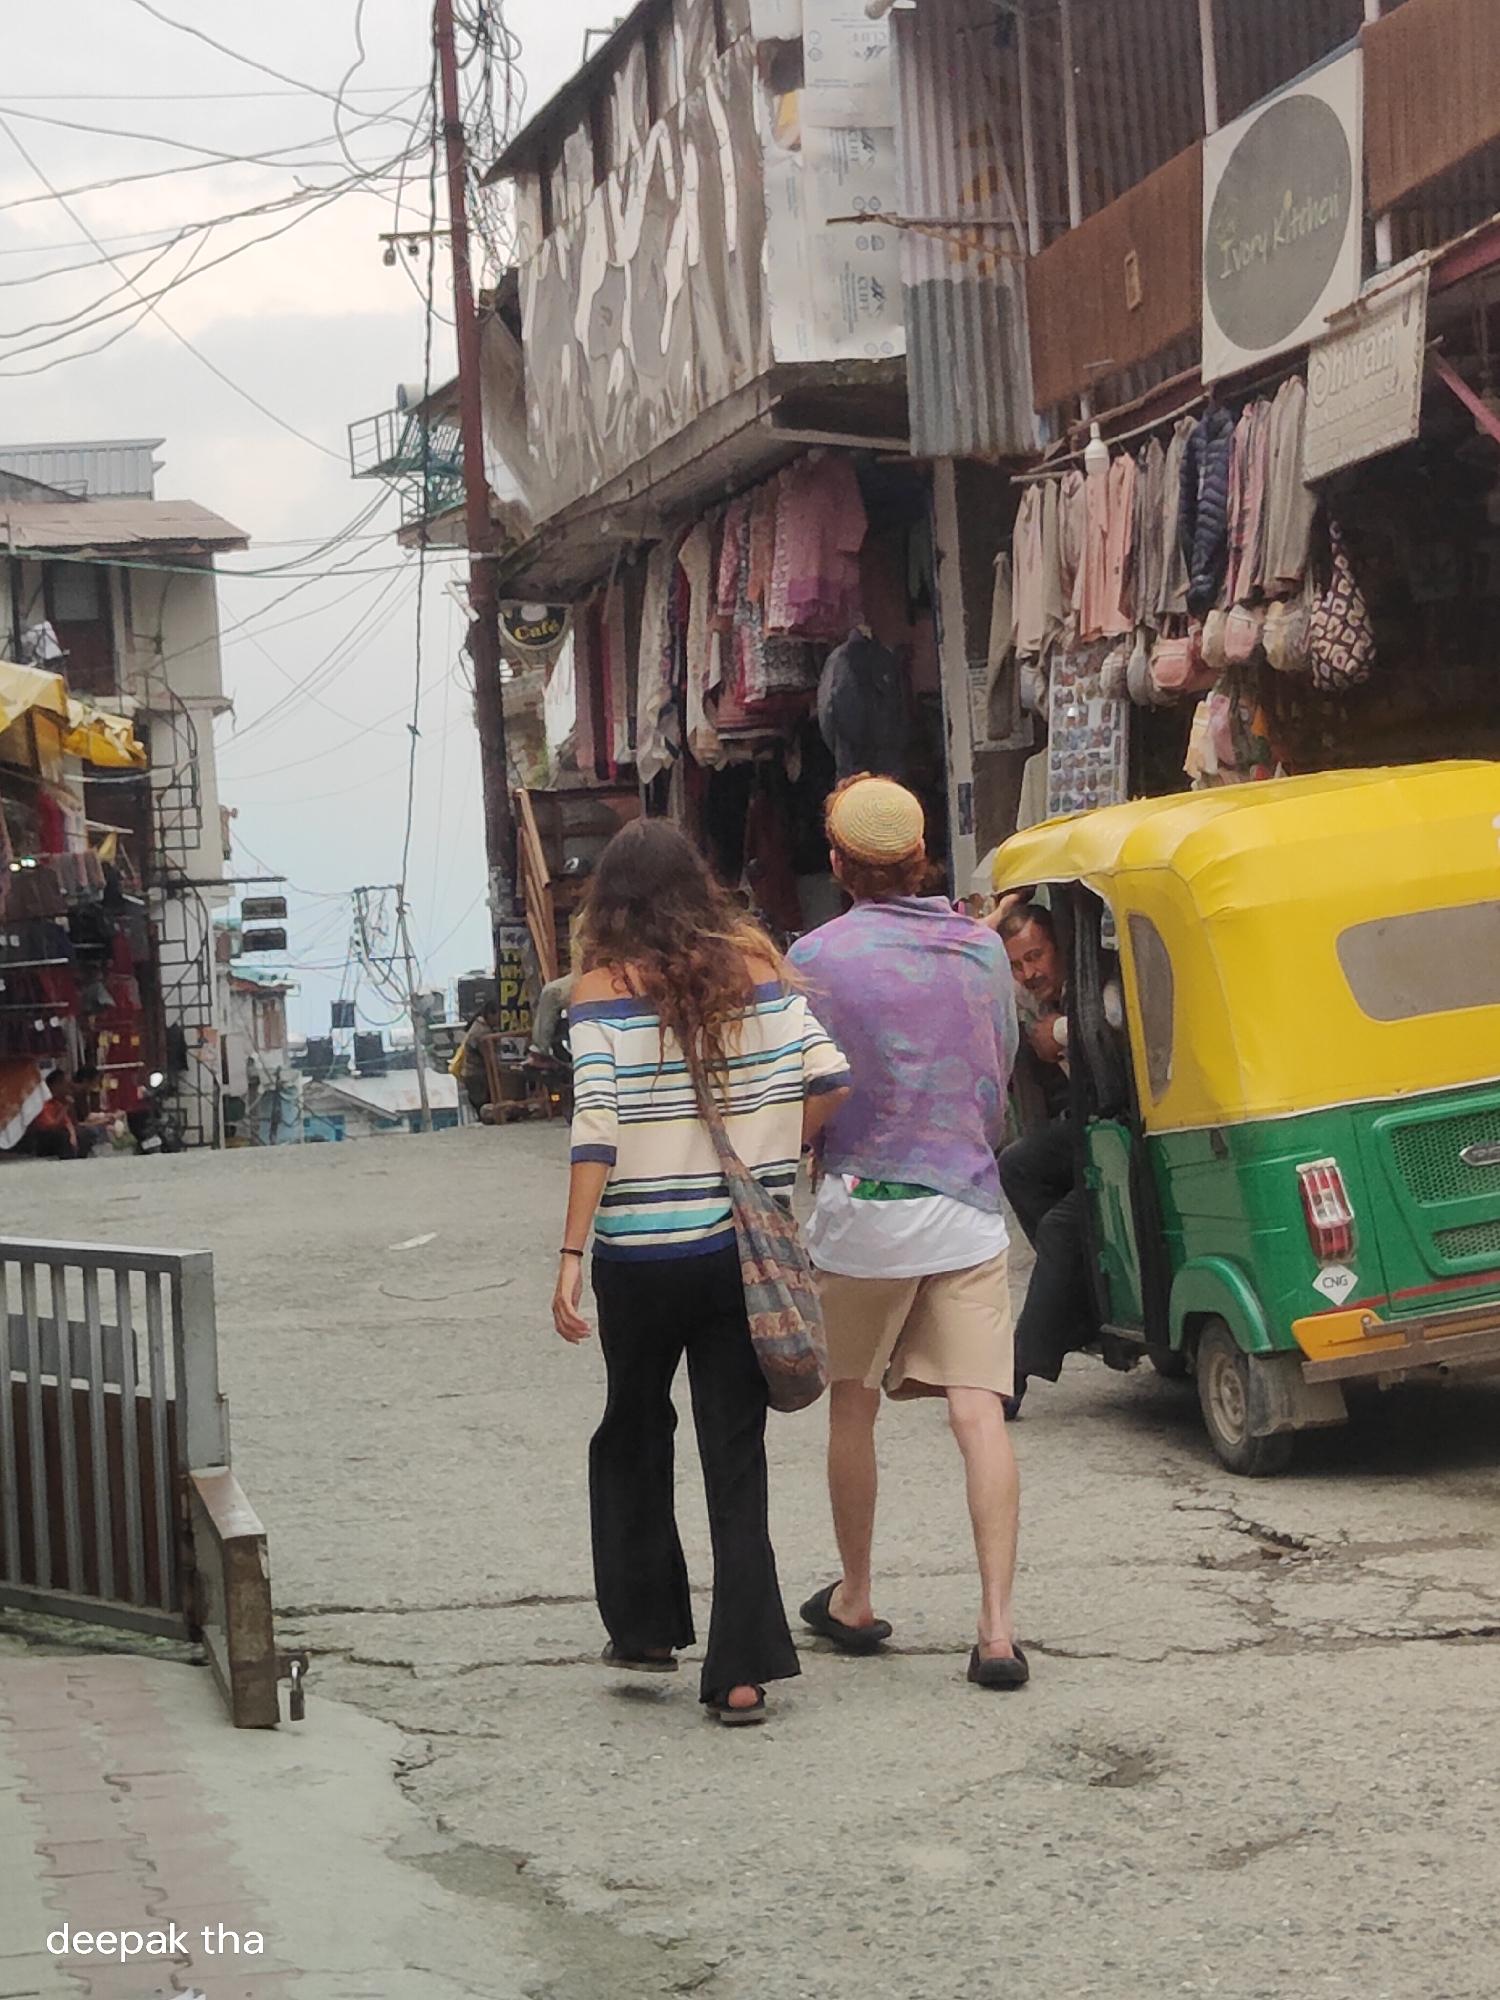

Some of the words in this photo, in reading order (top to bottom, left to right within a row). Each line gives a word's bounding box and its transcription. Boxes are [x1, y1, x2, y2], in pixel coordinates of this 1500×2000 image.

[1220, 231, 1268, 280] Ivory
[1273, 190, 1340, 250] Kitchen
[1322, 1274, 1349, 1289] CNG
